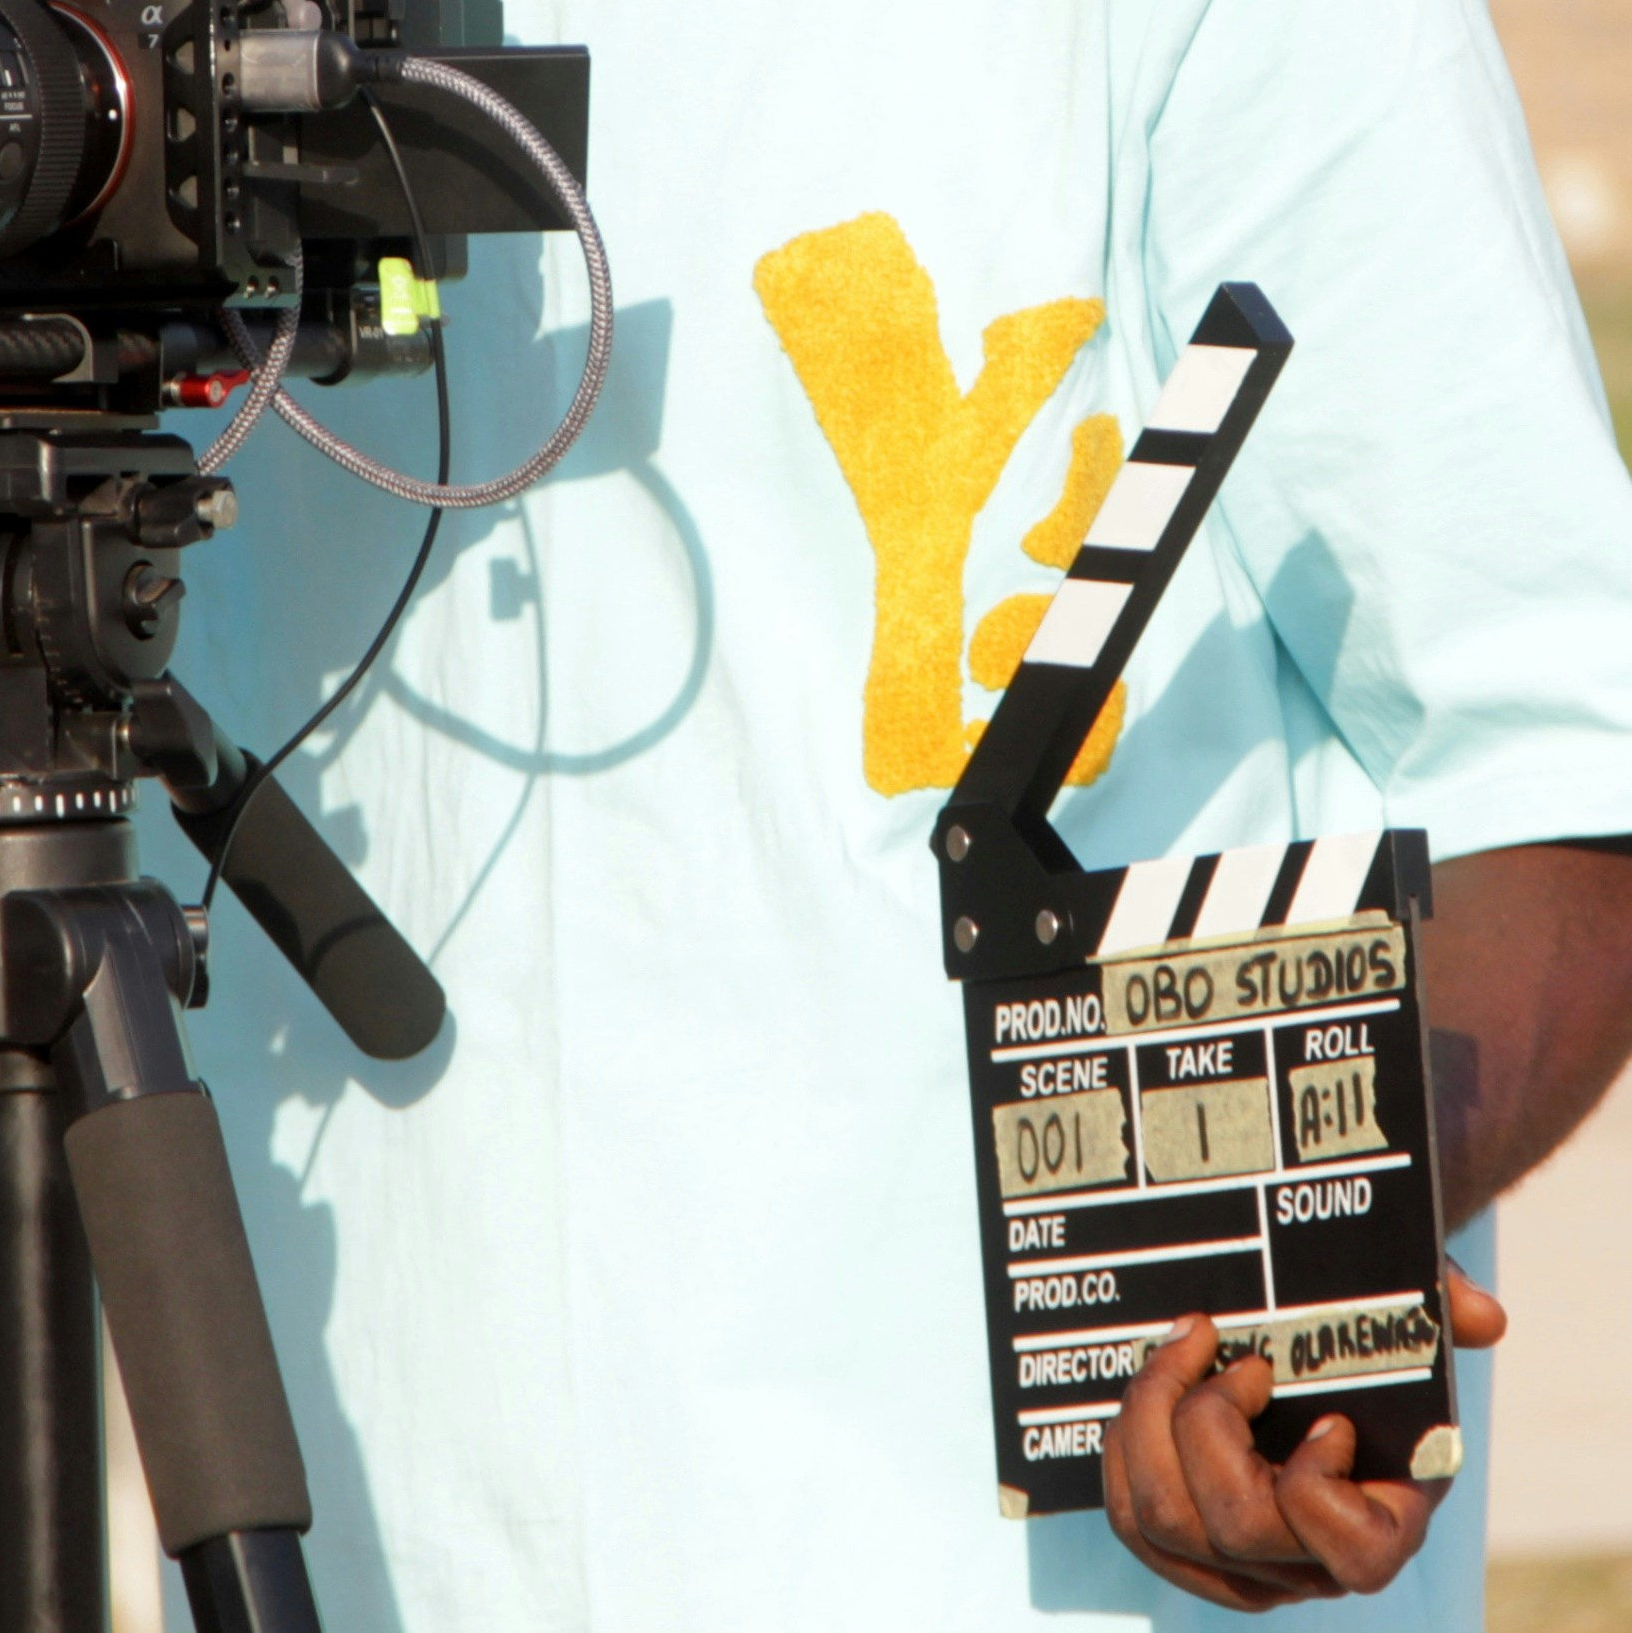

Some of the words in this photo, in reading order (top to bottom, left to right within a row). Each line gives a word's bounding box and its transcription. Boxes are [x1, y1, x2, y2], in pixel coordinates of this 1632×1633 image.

[148, 34, 159, 49] 7
[1125, 965, 1214, 1027] OBO
[1235, 940, 1397, 1007] STUDIOS
[995, 994, 1106, 1043] PROD.NO.
[1166, 1042, 1233, 1080] TAKE
[1305, 1023, 1375, 1061] ROLL
[1020, 1057, 1108, 1099] SCENE
[1017, 1111, 1084, 1185] 001
[1276, 1178, 1372, 1224] SOUND
[1009, 1216, 1066, 1253] DATE
[1014, 1273, 1121, 1312] PROD.CO.
[1019, 1345, 1134, 1388] DIRECTOR
[1023, 1420, 1104, 1462] CAMER
